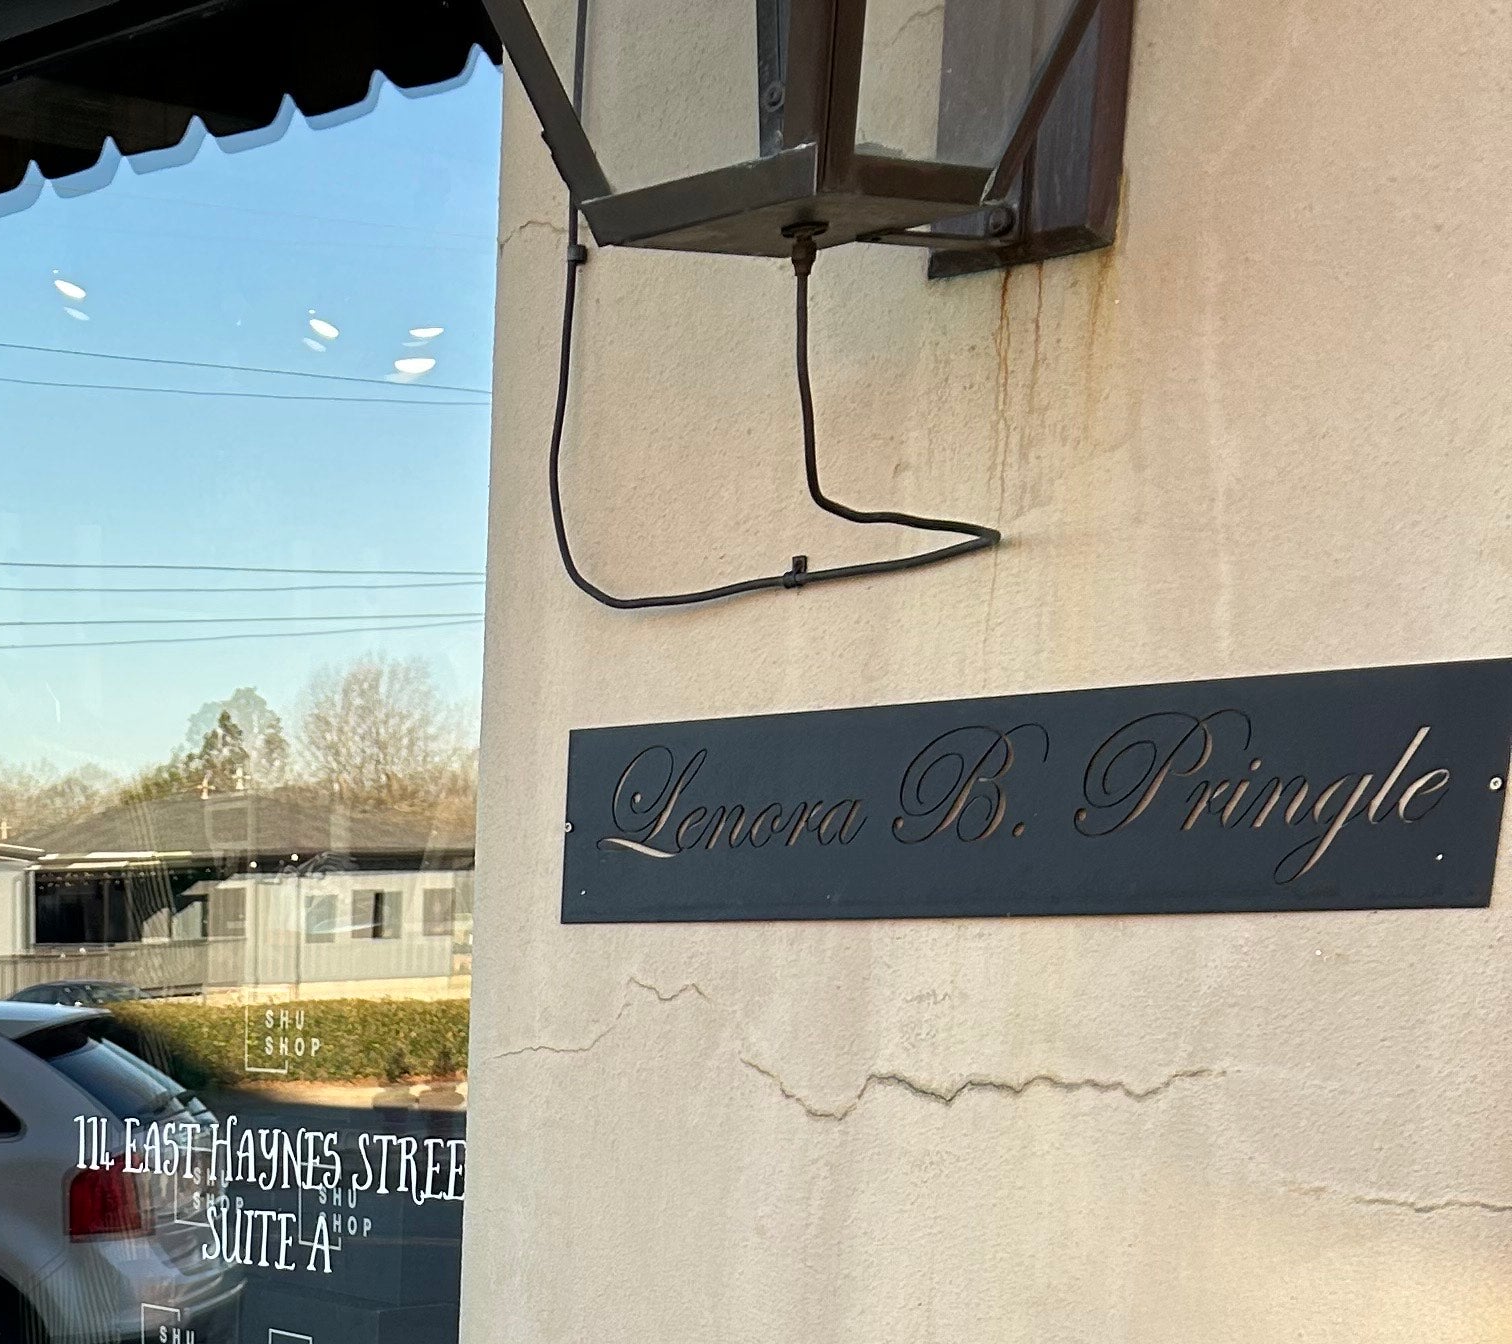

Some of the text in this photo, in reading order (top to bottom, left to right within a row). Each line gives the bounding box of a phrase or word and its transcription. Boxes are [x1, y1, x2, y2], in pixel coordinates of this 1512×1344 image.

[597, 709, 1450, 884] Lenora B. Pringle
[264, 1009, 305, 1031] SHU
[264, 1036, 321, 1057] SHOP
[73, 1115, 467, 1206] 114 EAST HAYNES STREE
[202, 1205, 333, 1274] SUITE A
[319, 1211, 372, 1238] HOP
